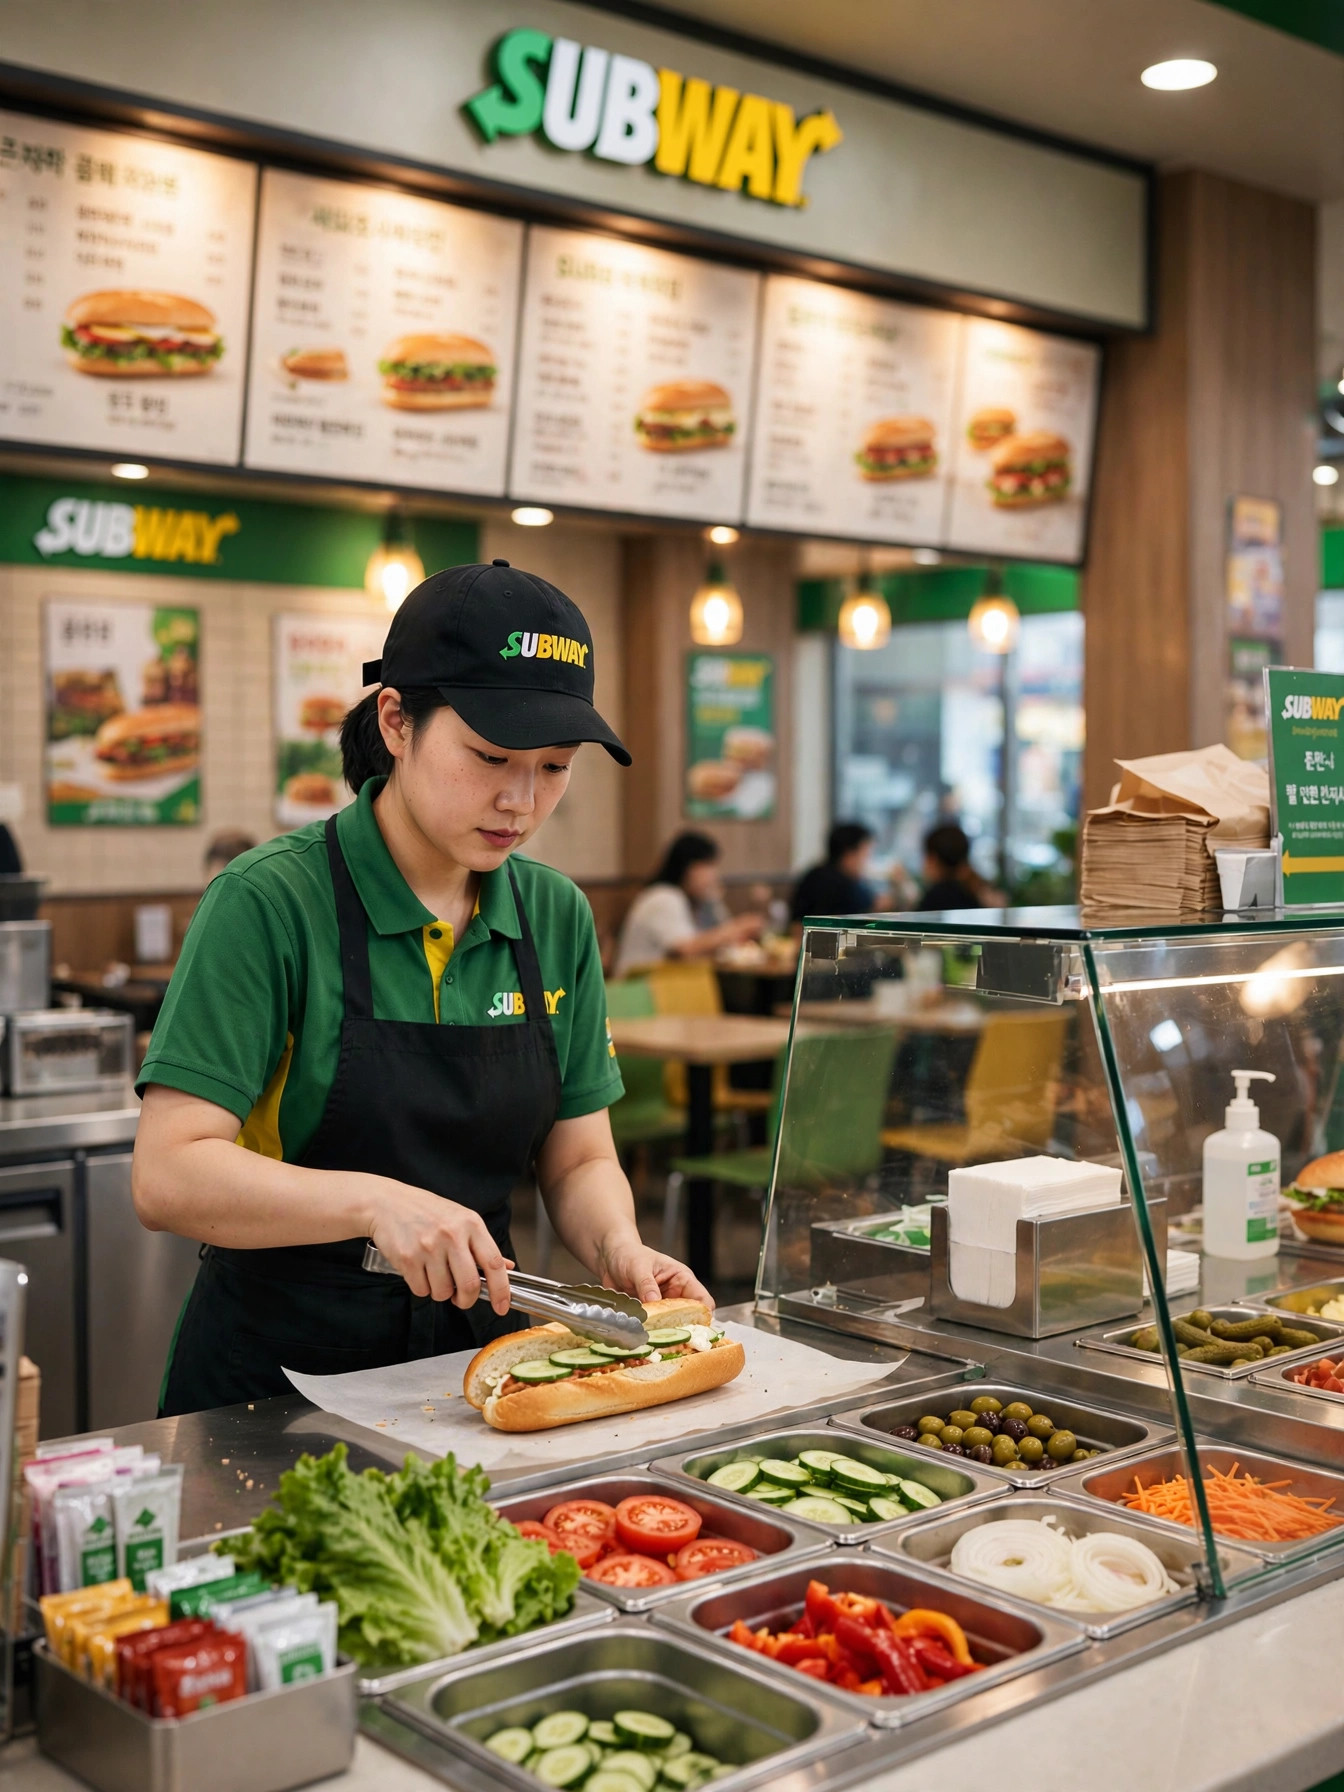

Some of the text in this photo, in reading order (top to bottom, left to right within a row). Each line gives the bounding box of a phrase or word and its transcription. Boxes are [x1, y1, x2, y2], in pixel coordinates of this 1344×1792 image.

[467, 28, 842, 208] SUBWAY
[34, 497, 241, 564] SUBWAY
[499, 631, 589, 669] SUBWAY
[1281, 694, 1344, 721] SUBWAY
[487, 987, 566, 1019] SUBY
